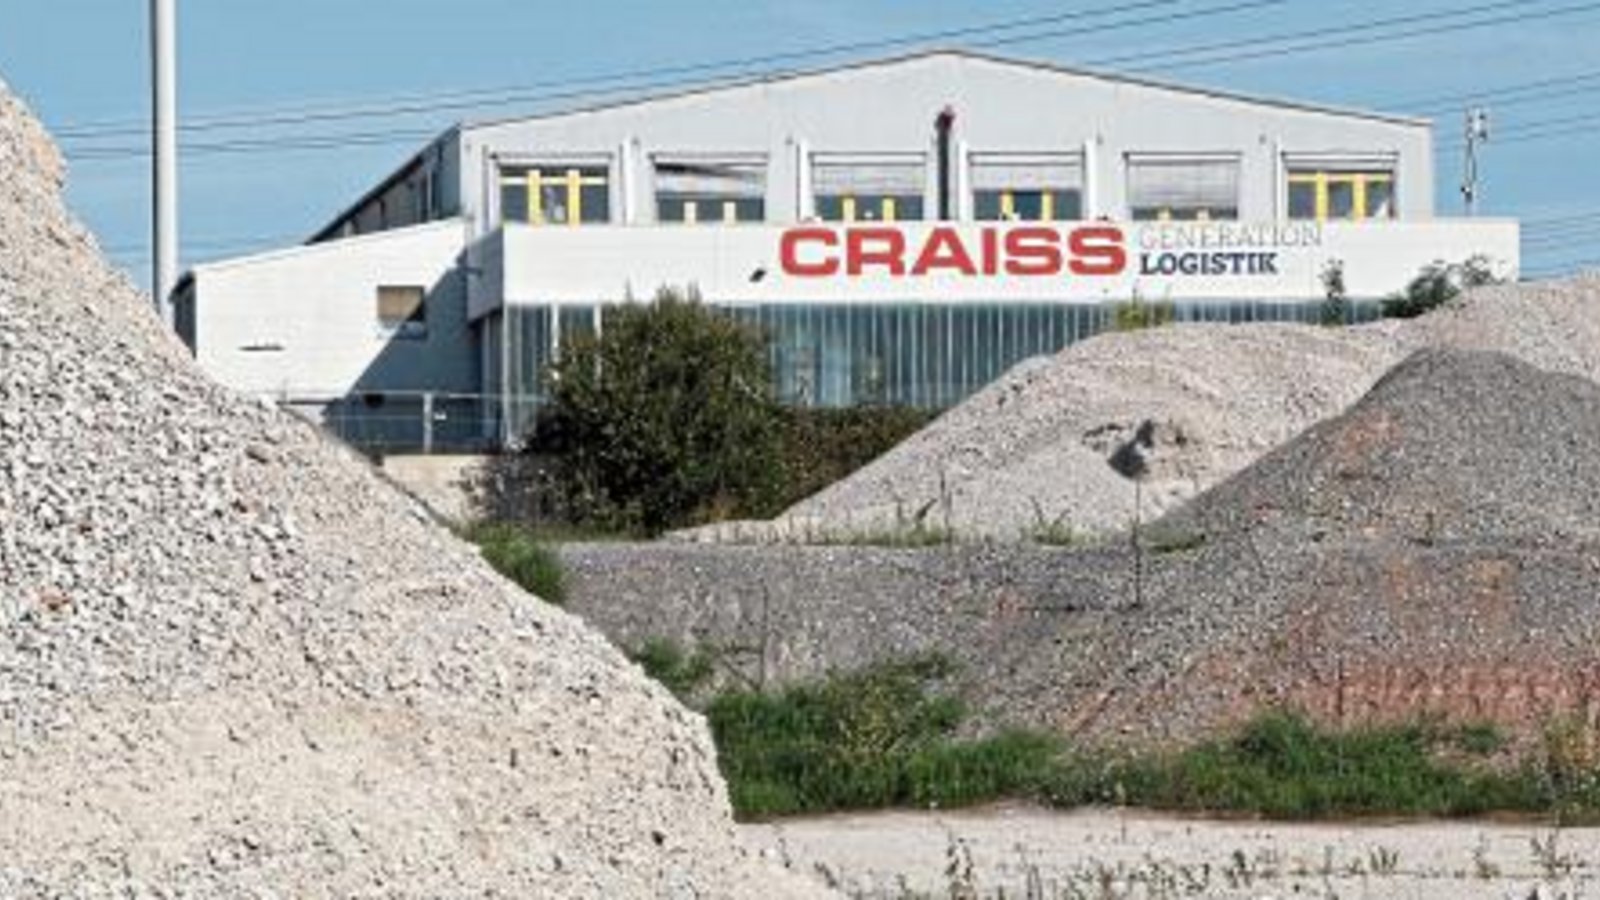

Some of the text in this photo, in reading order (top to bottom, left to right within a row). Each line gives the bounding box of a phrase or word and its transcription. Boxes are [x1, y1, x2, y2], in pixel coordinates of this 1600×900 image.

[1139, 224, 1322, 247] GENERATION
[779, 227, 1126, 276] CRAISS
[1139, 252, 1278, 275] LOGISTIK
